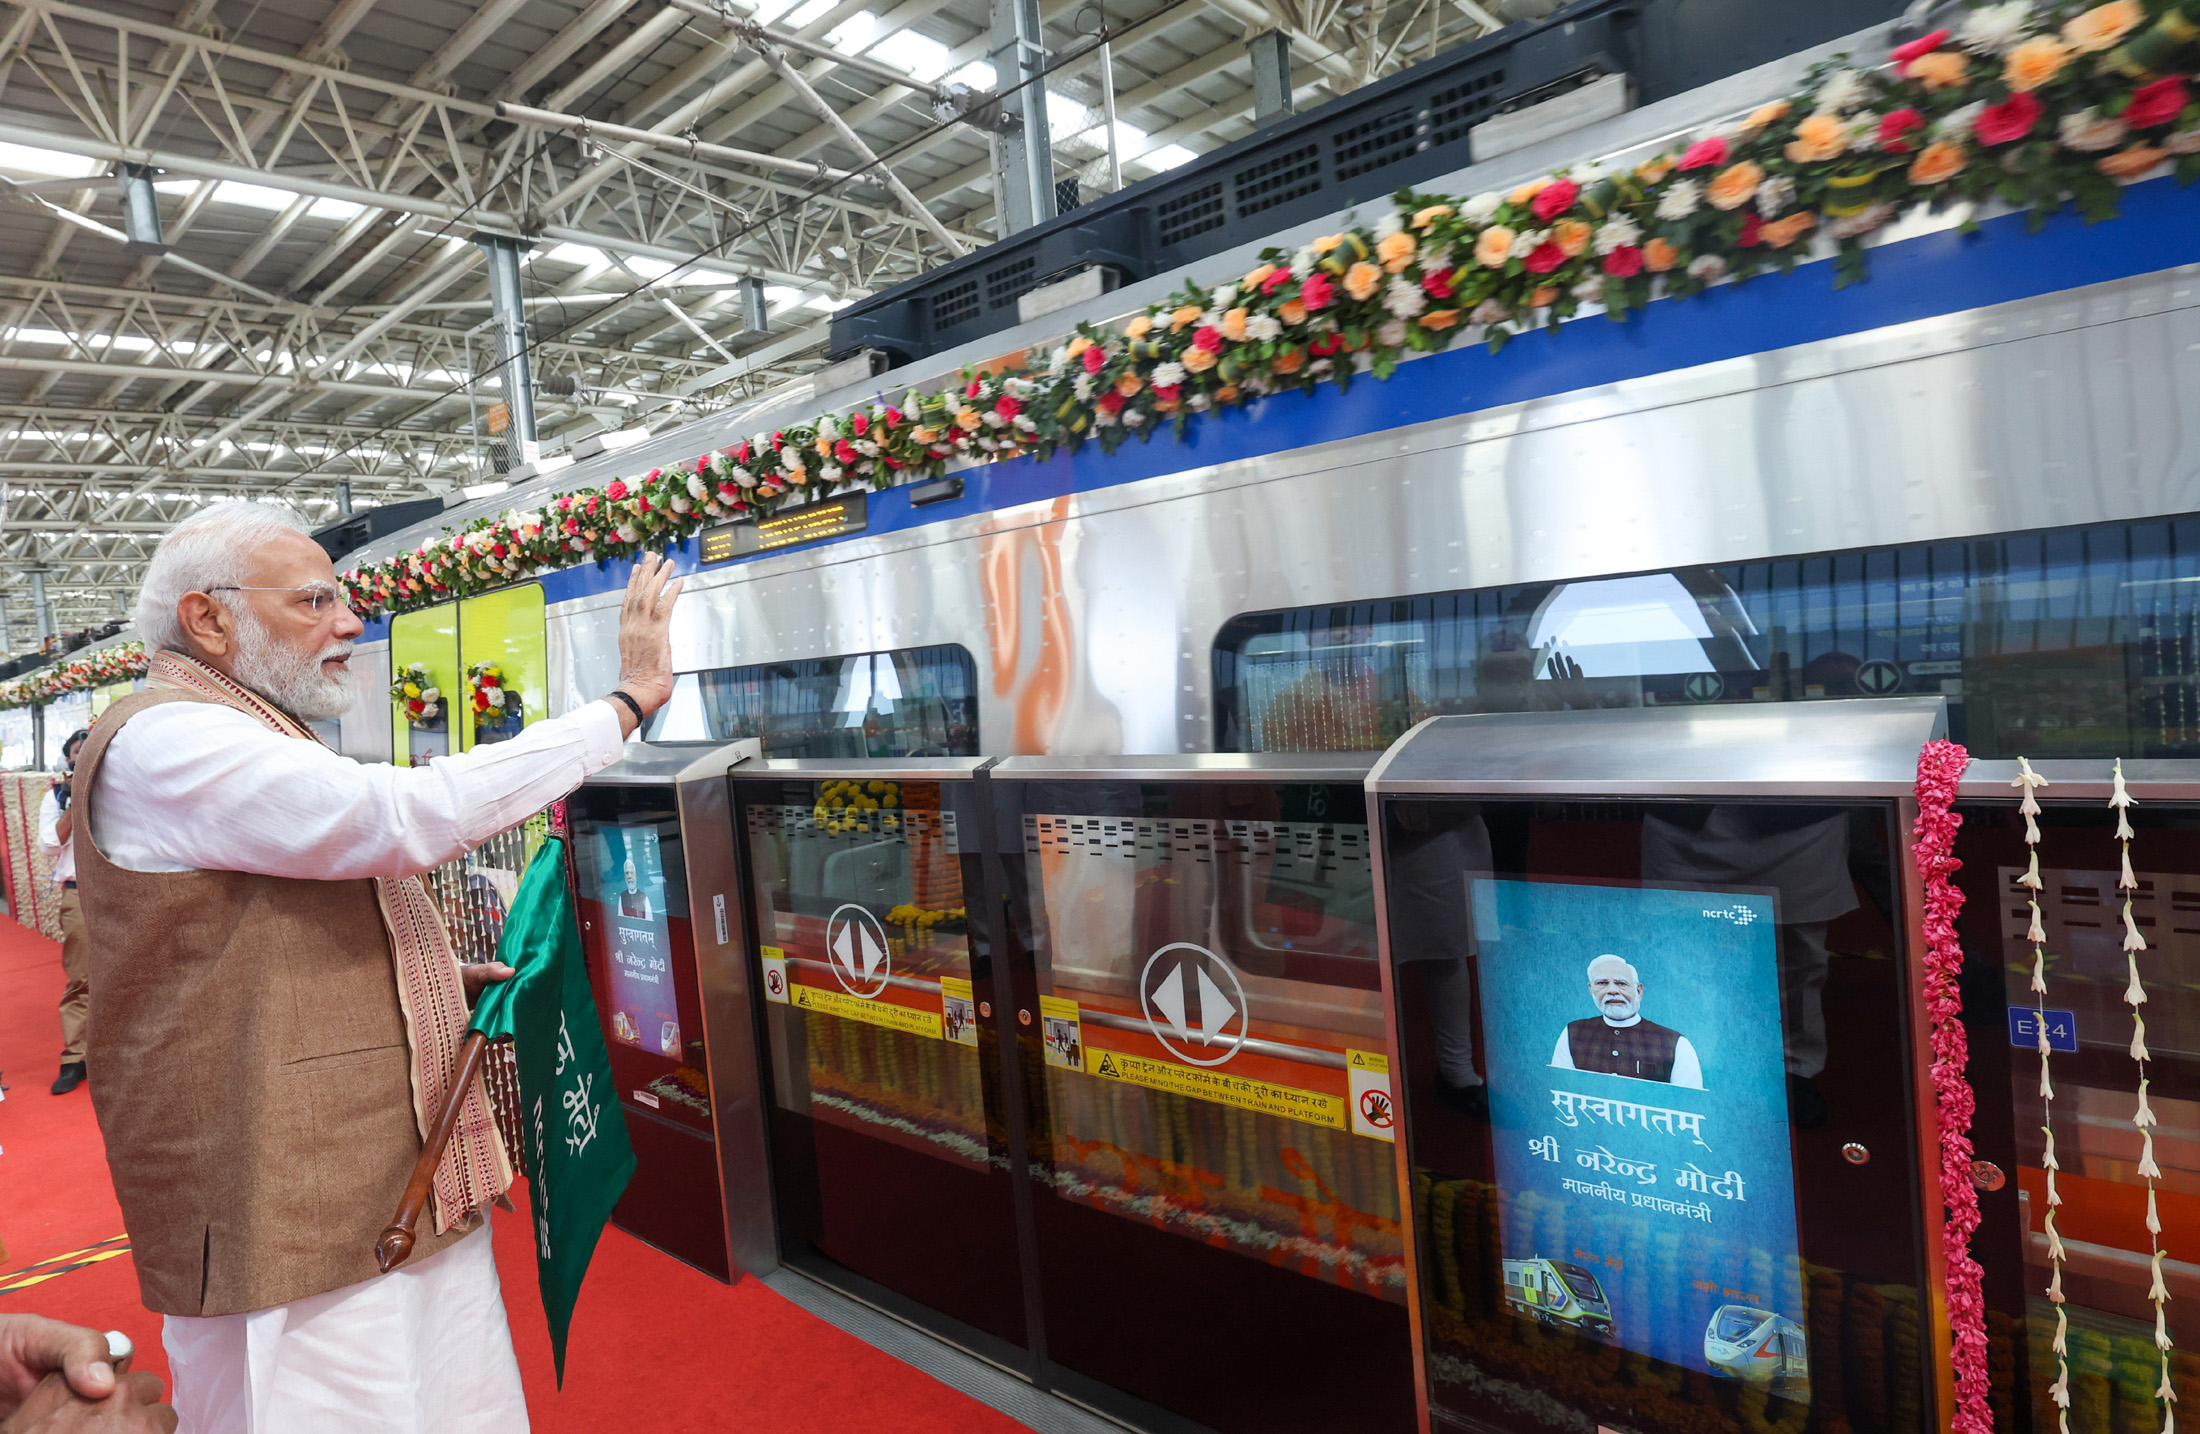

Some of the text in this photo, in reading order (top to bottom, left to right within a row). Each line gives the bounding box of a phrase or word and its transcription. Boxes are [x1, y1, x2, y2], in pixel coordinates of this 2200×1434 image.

[1702, 909, 1736, 920] ncrtc
[618, 926, 658, 951] सुस्वागतम्
[1122, 1072, 1335, 1123] PLEASE MIND THE GAP BETWEEN TRAIN AND PLATFORM
[1156, 1065, 1172, 1077] और
[1212, 1075, 1221, 1086] के
[1270, 1090, 1282, 1100] का
[1284, 1092, 1310, 1105] ध्यान
[1550, 1089, 1712, 1152] सुस्वागतम्
[1528, 1135, 1746, 1201] श्री नरेन्द्र मोदी
[1562, 1178, 1712, 1223] माननीय प्रधानमंत्री
[1722, 1287, 1760, 1304] भारत
